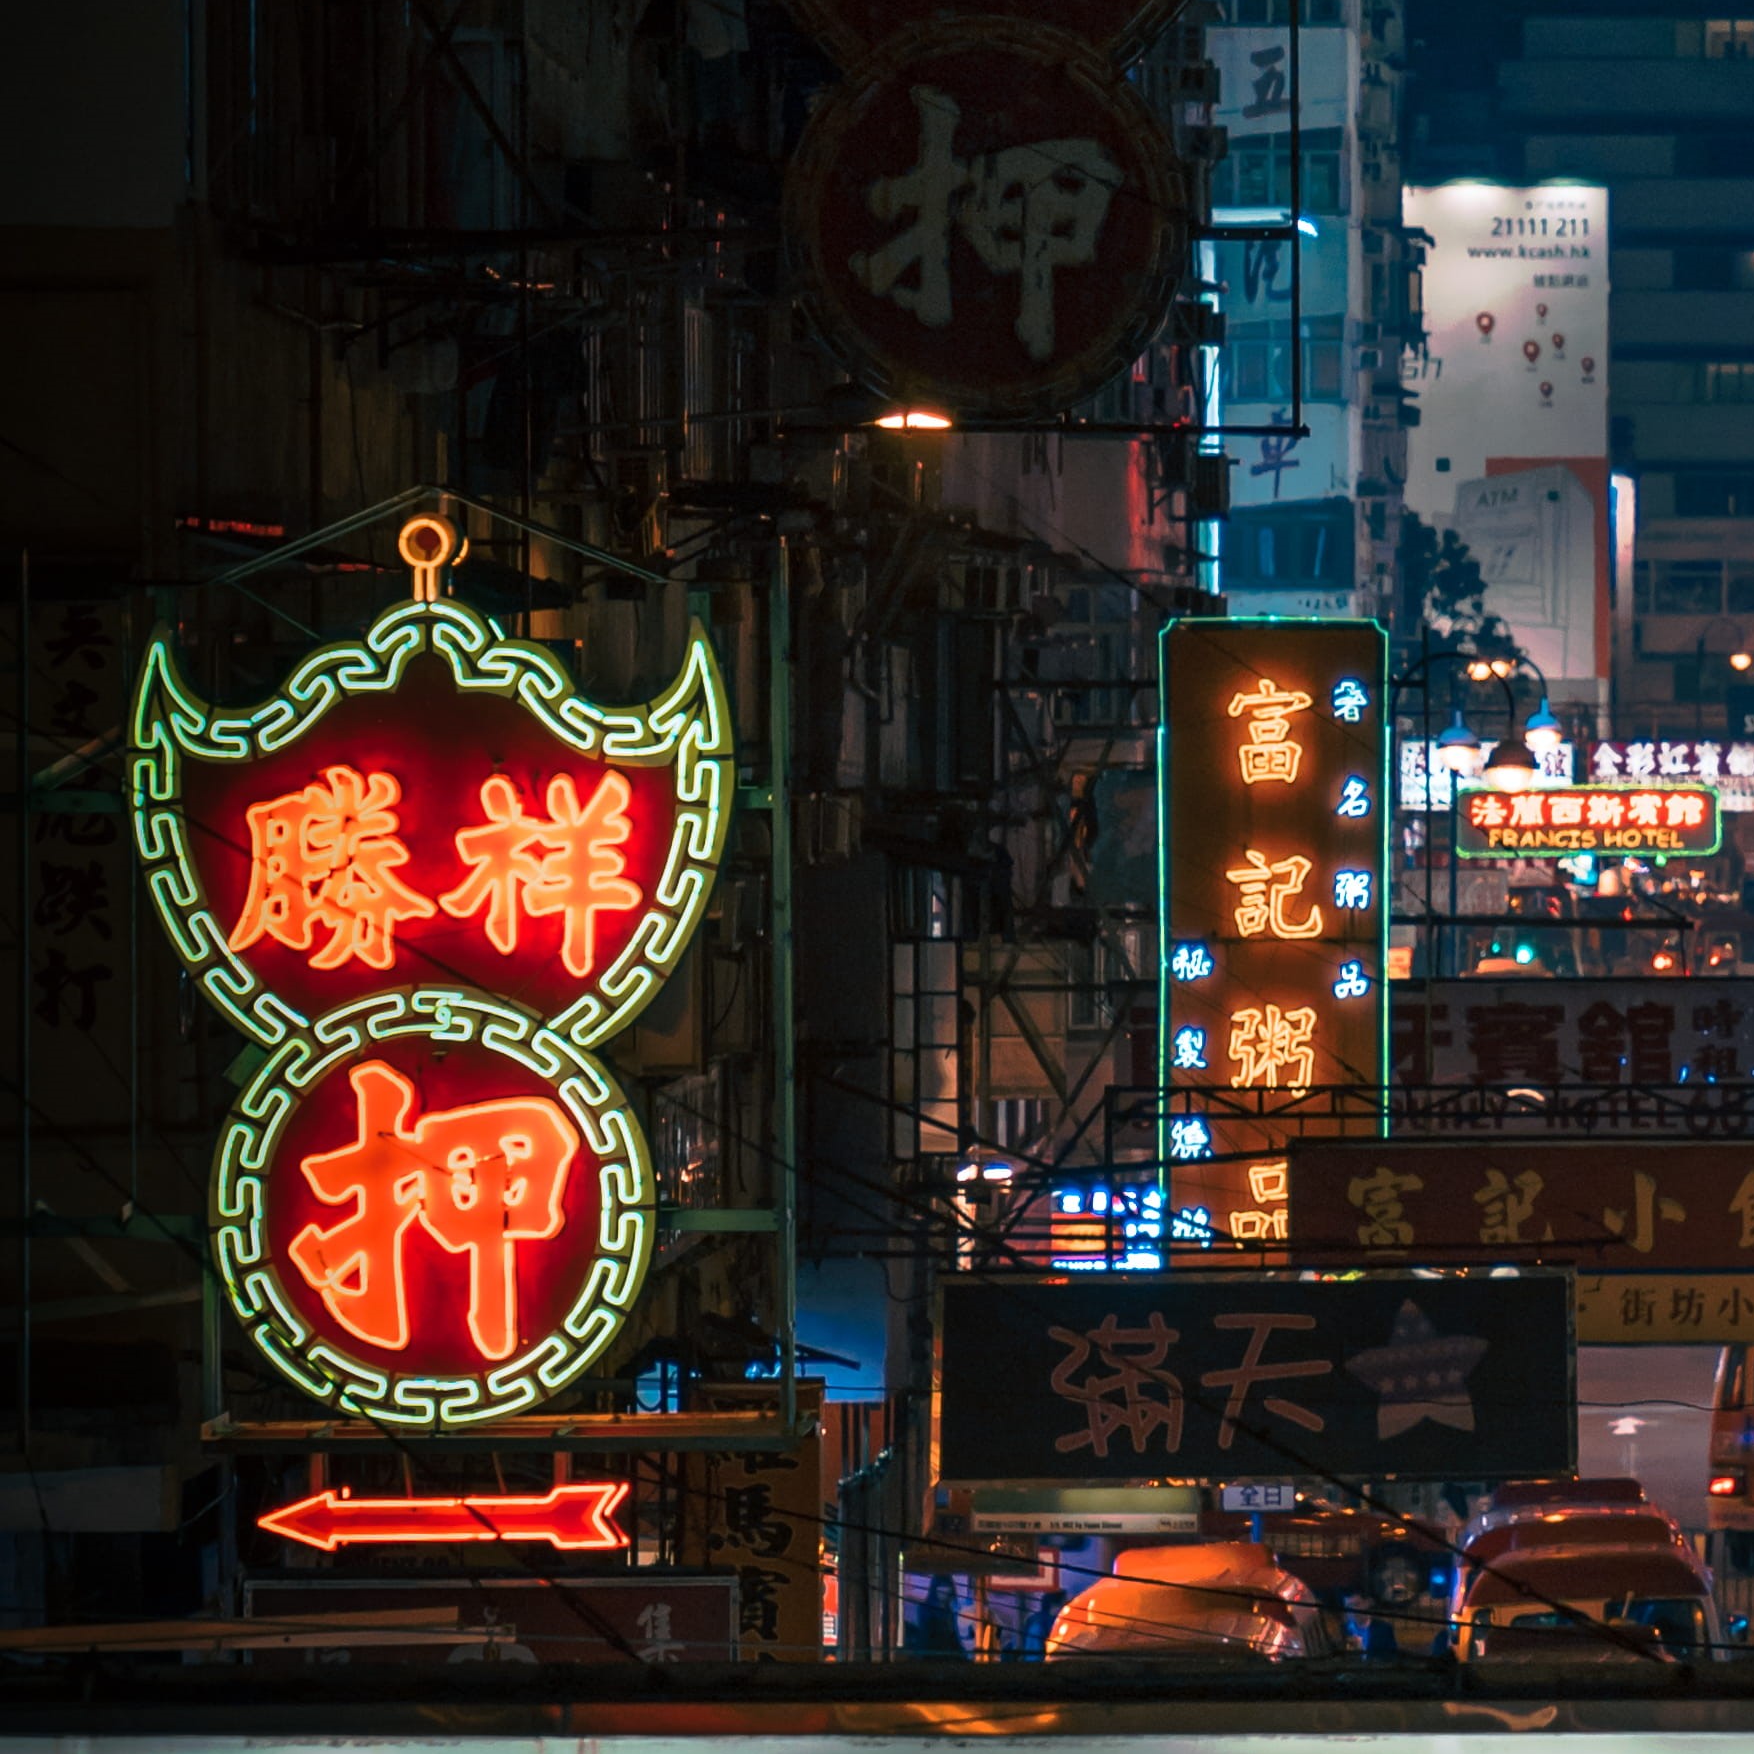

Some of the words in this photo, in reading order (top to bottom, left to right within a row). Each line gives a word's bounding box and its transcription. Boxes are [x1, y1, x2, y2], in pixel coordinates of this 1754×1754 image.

[849, 85, 1125, 362] 押
[1491, 218, 1548, 237] 21111
[1556, 218, 1590, 237] 211
[1467, 245, 1591, 259] www.kcash.hk
[1476, 486, 1519, 509] ATM
[1488, 829, 1597, 849] FRANCIS
[1603, 829, 1685, 849] HOTEL
[1226, 679, 1323, 1245] 富記粥品
[287, 1059, 579, 1358] 押
[1240, 1485, 1281, 1506] 全日
